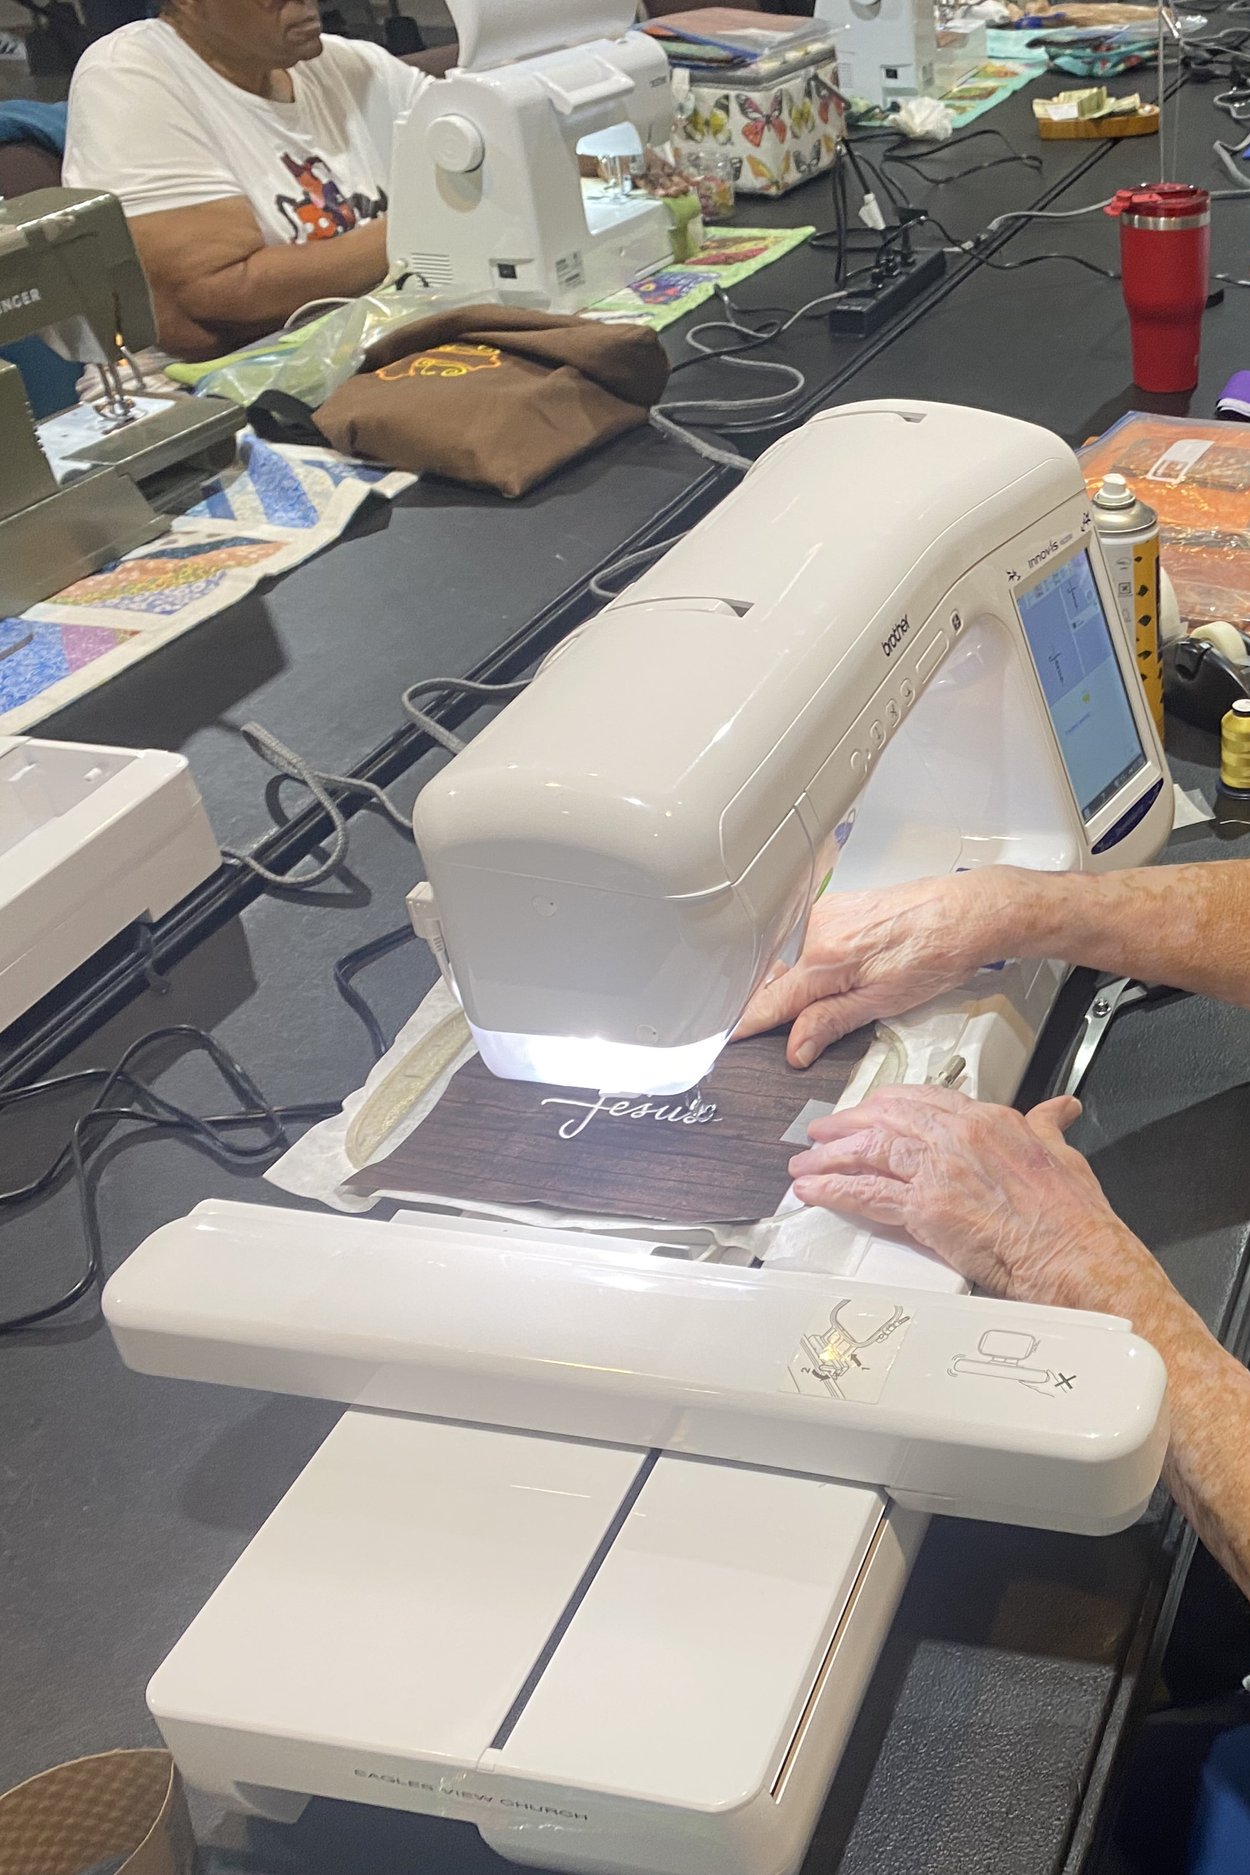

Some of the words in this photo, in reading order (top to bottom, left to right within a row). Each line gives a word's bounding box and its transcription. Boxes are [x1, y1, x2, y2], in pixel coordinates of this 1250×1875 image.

[0, 288, 41, 314] NGER
[881, 613, 910, 656] brother
[442, 1786, 493, 1802] VIEW
[500, 1799, 588, 1820] CHURCH
